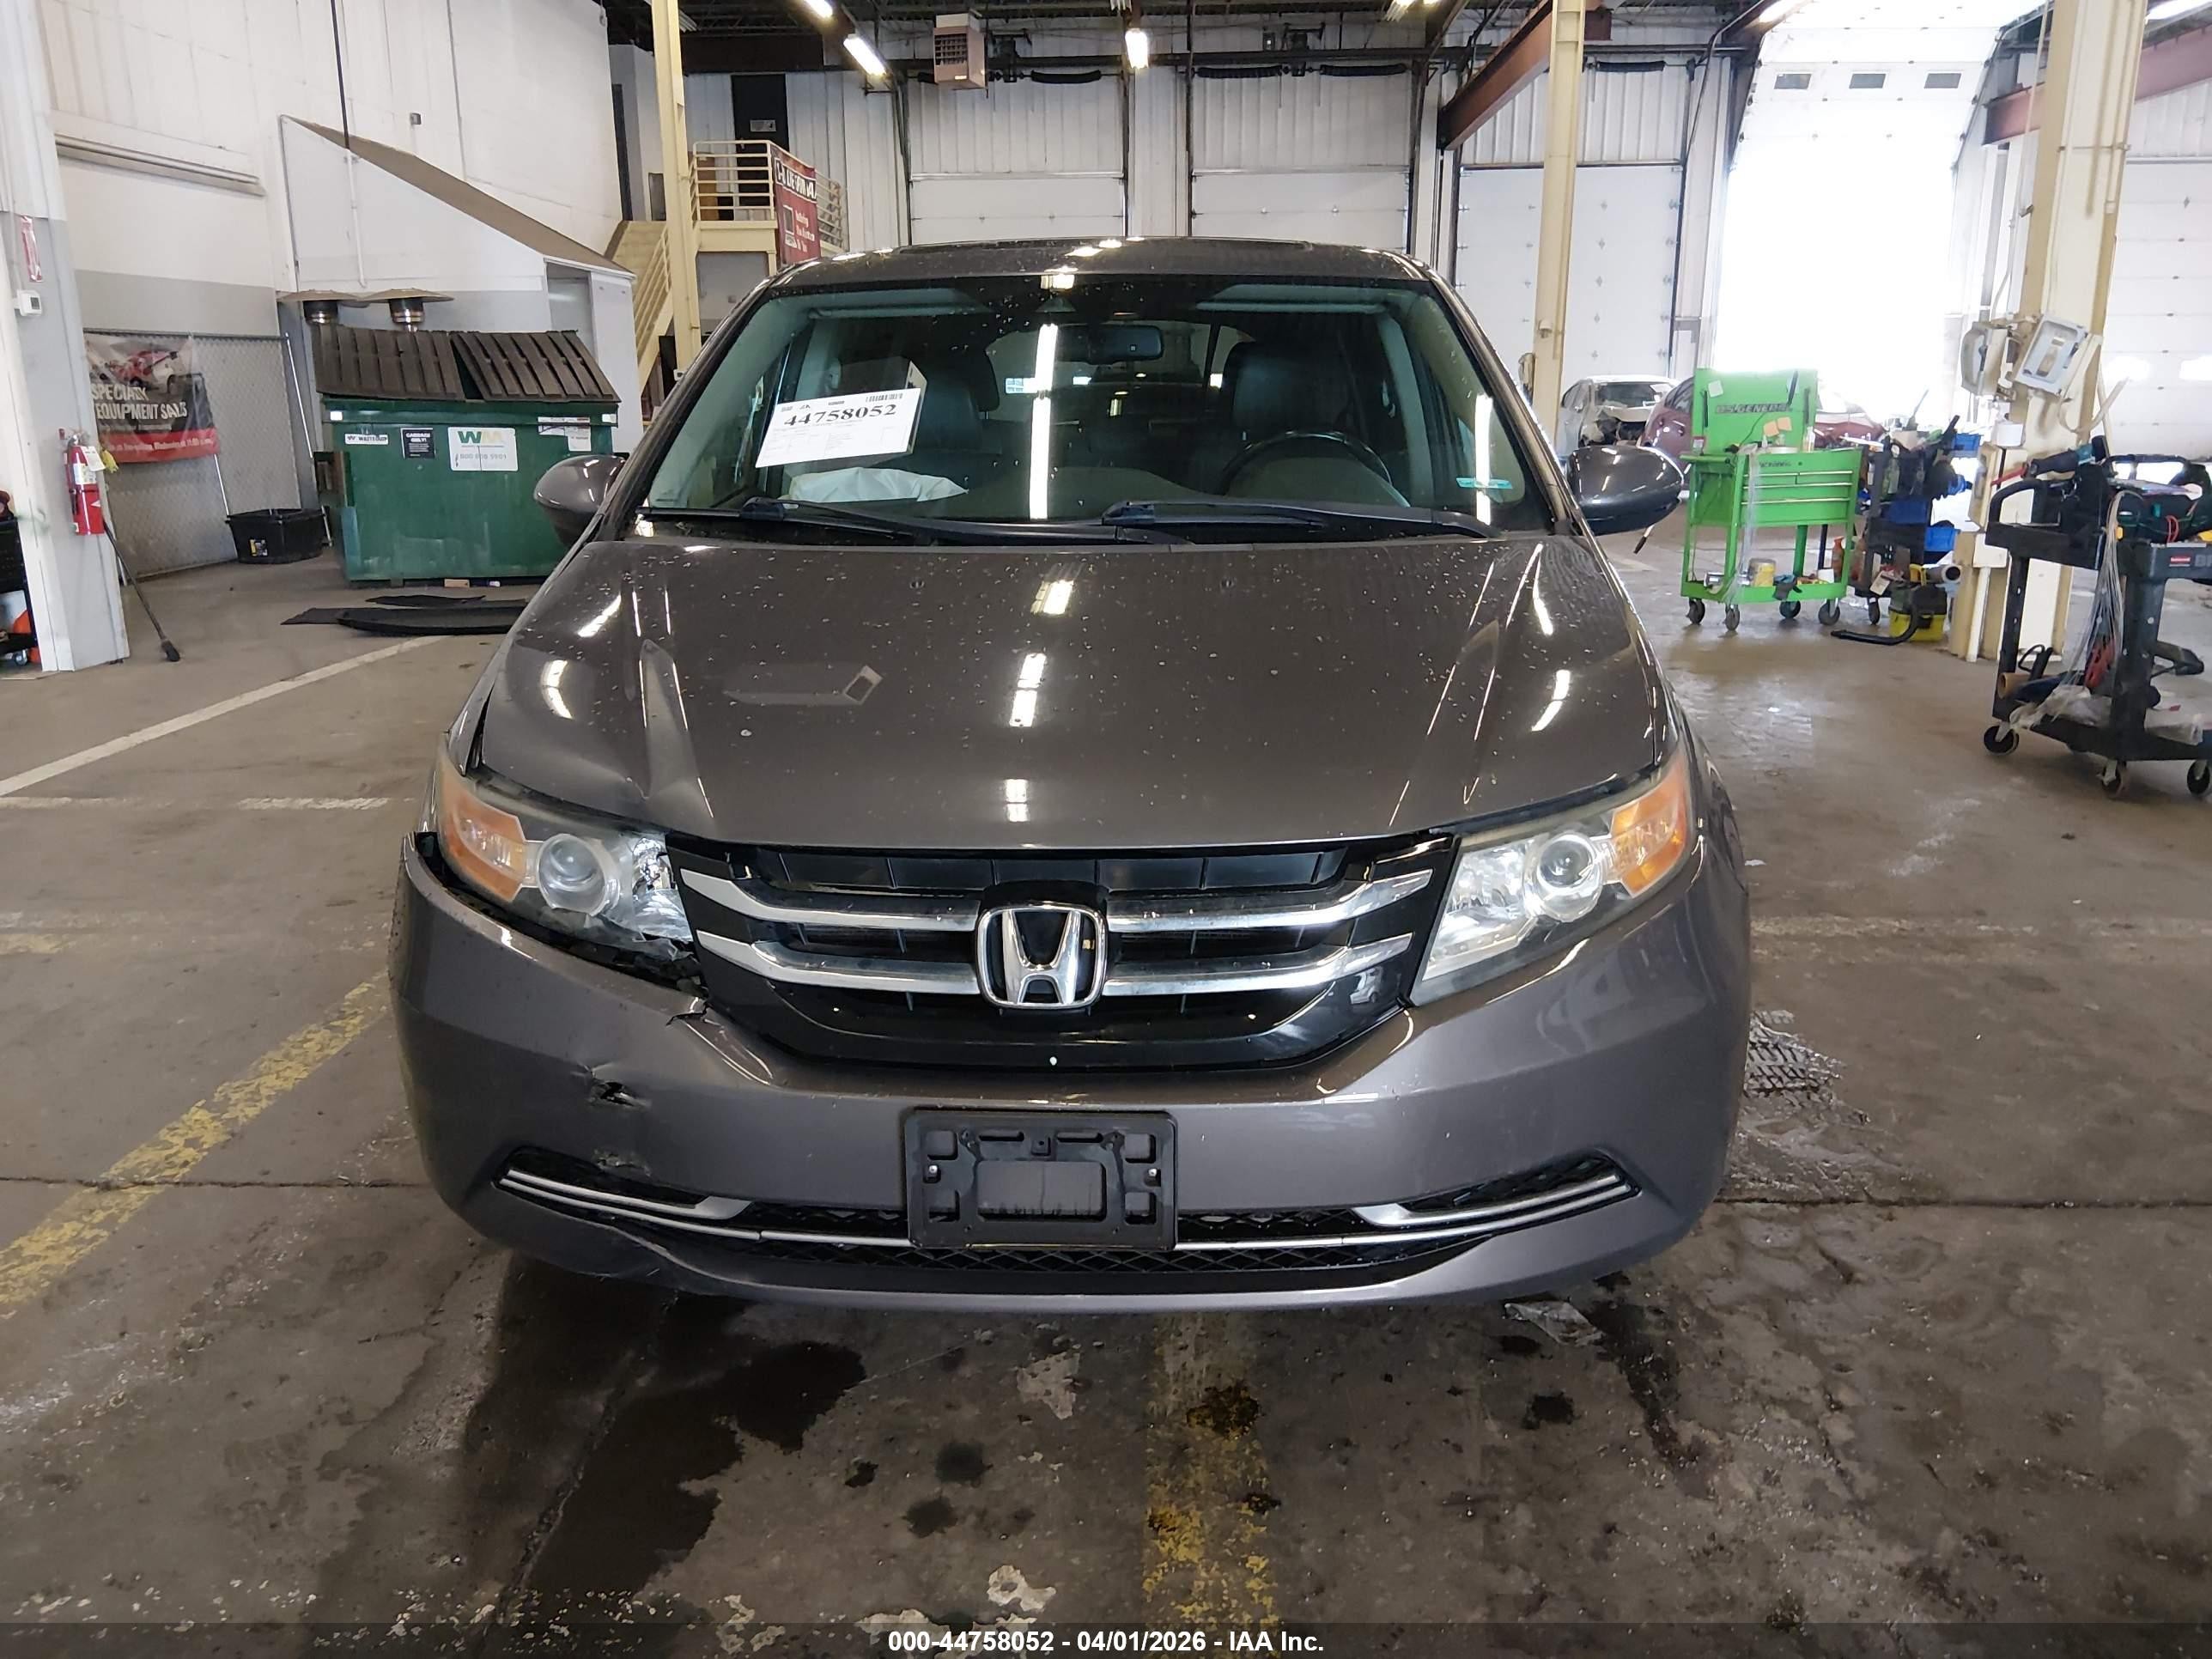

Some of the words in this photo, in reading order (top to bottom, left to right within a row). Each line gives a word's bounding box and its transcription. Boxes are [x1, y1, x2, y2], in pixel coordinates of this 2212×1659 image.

[97, 403, 159, 420] EQUIPMENT
[784, 404, 896, 427] 44758052
[457, 430, 502, 444] WM
